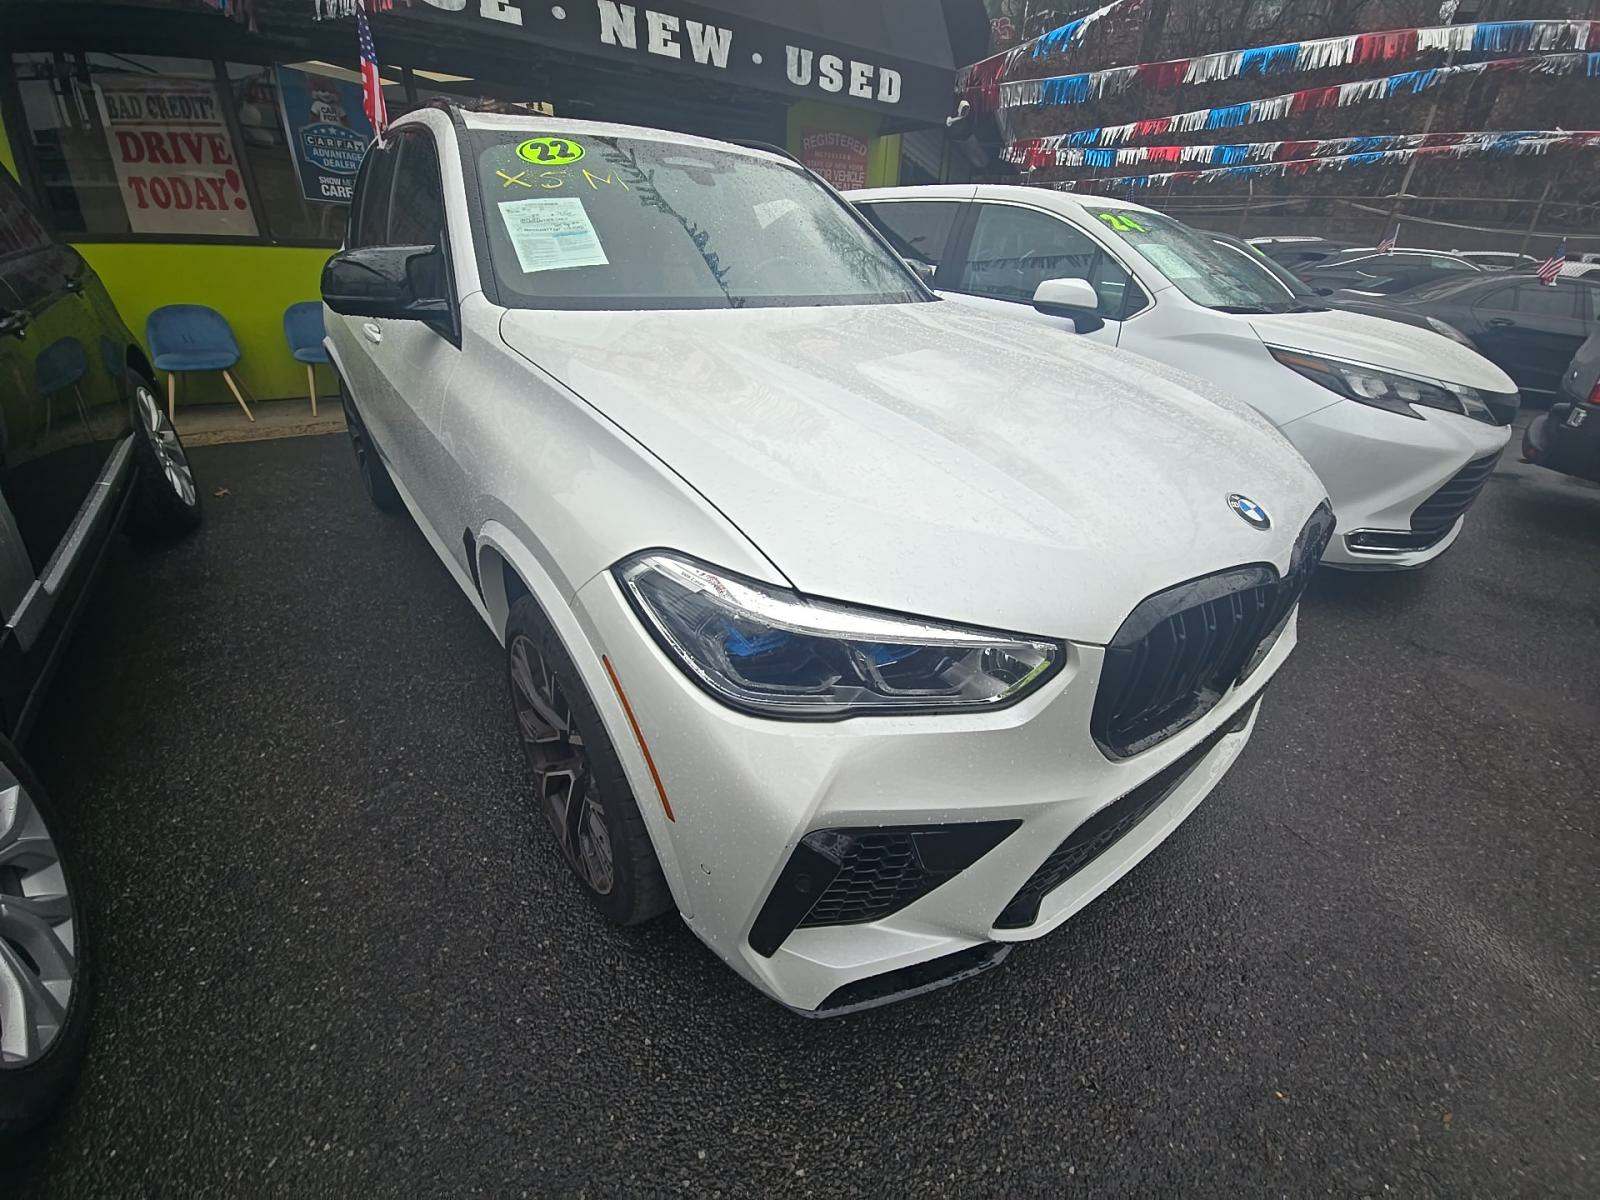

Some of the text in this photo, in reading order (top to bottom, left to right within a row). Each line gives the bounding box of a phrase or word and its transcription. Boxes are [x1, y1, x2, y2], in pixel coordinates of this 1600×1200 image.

[600, 0, 732, 68] NEW
[785, 45, 902, 103] USED
[106, 95, 142, 119] BAD
[115, 131, 232, 165] DRIVE
[306, 136, 365, 152] CARFAX
[312, 148, 363, 161] ADVANTAGE
[530, 141, 575, 161] 22
[803, 132, 867, 156] REGISTERED
[323, 159, 357, 169] DEALER
[127, 169, 247, 210] TODAY!
[318, 176, 341, 185] SHOW
